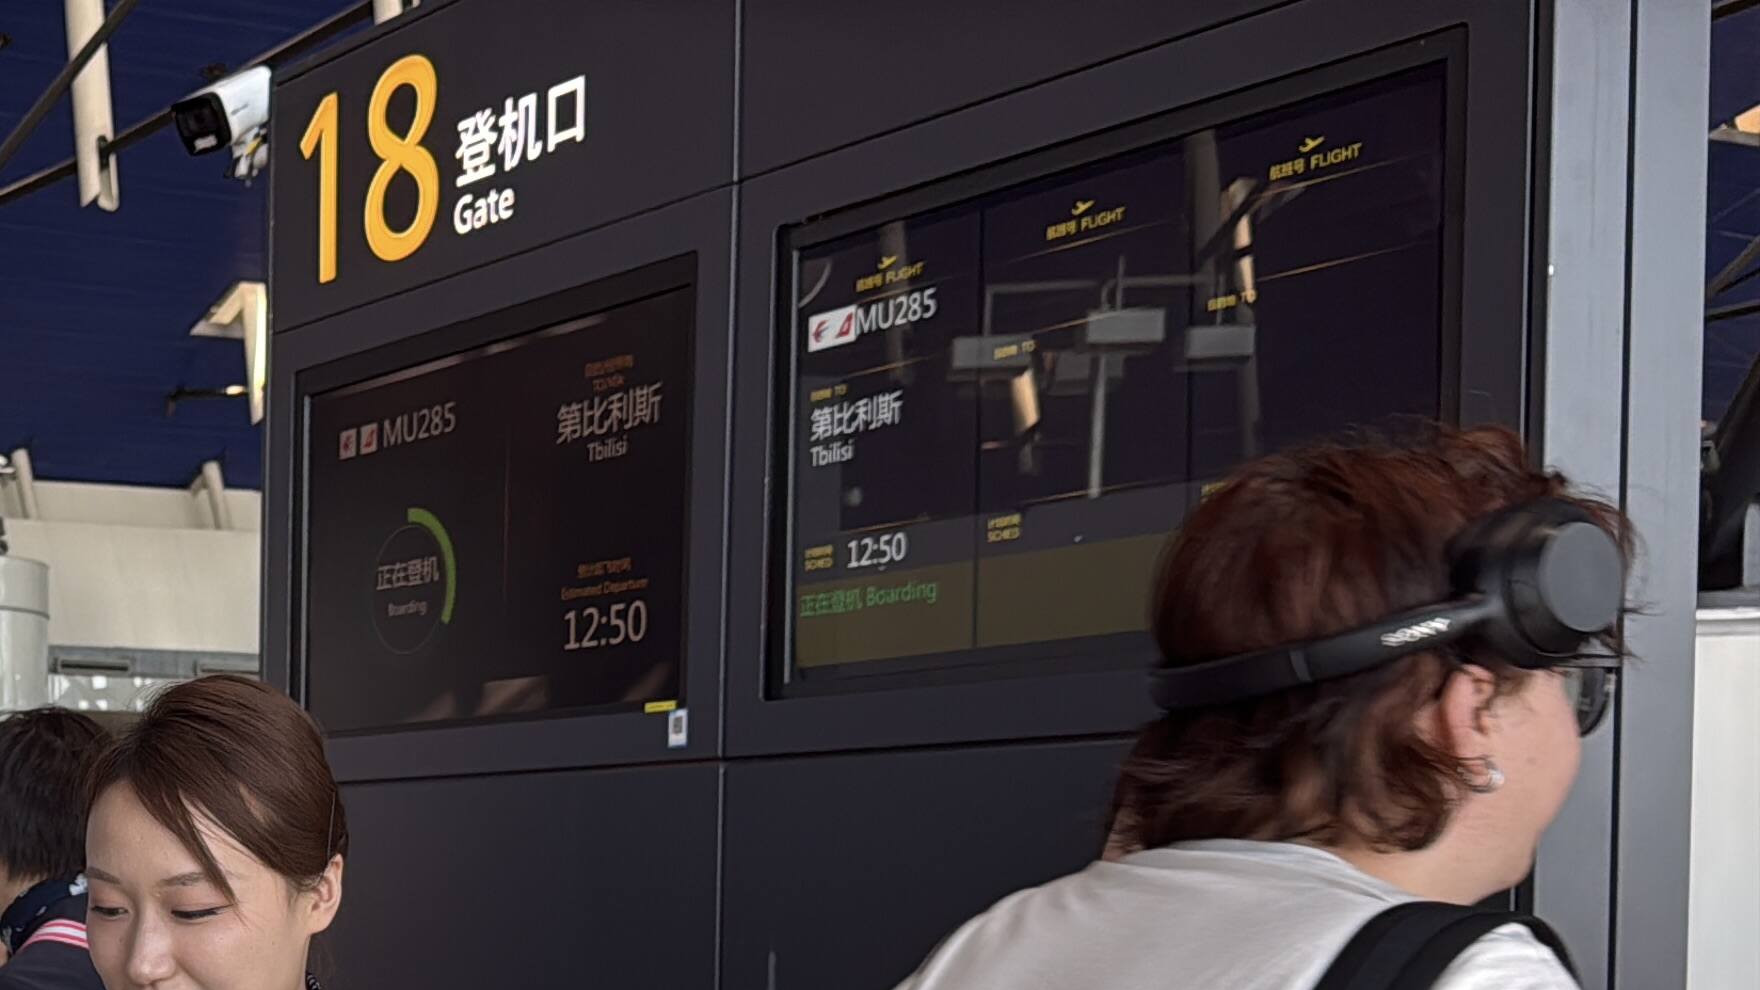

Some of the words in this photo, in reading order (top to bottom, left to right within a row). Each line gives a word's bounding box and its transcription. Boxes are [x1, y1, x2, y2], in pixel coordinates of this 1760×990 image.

[455, 75, 587, 188] 登机口
[299, 54, 440, 284] 18
[1310, 142, 1362, 169] FLIGHT
[453, 188, 515, 235] Gate
[1080, 206, 1126, 231] FLIGHT
[857, 287, 937, 333] MU285
[382, 401, 456, 448] MU285
[556, 381, 662, 444] 第比利斯
[810, 389, 903, 442] 第比利斯
[586, 434, 628, 462] Tbilisi
[809, 439, 854, 467] Tbilisi
[376, 556, 440, 590] 正在登机
[846, 532, 907, 569] 12:50
[865, 582, 937, 604] Boarding
[563, 600, 648, 650] 12:50
